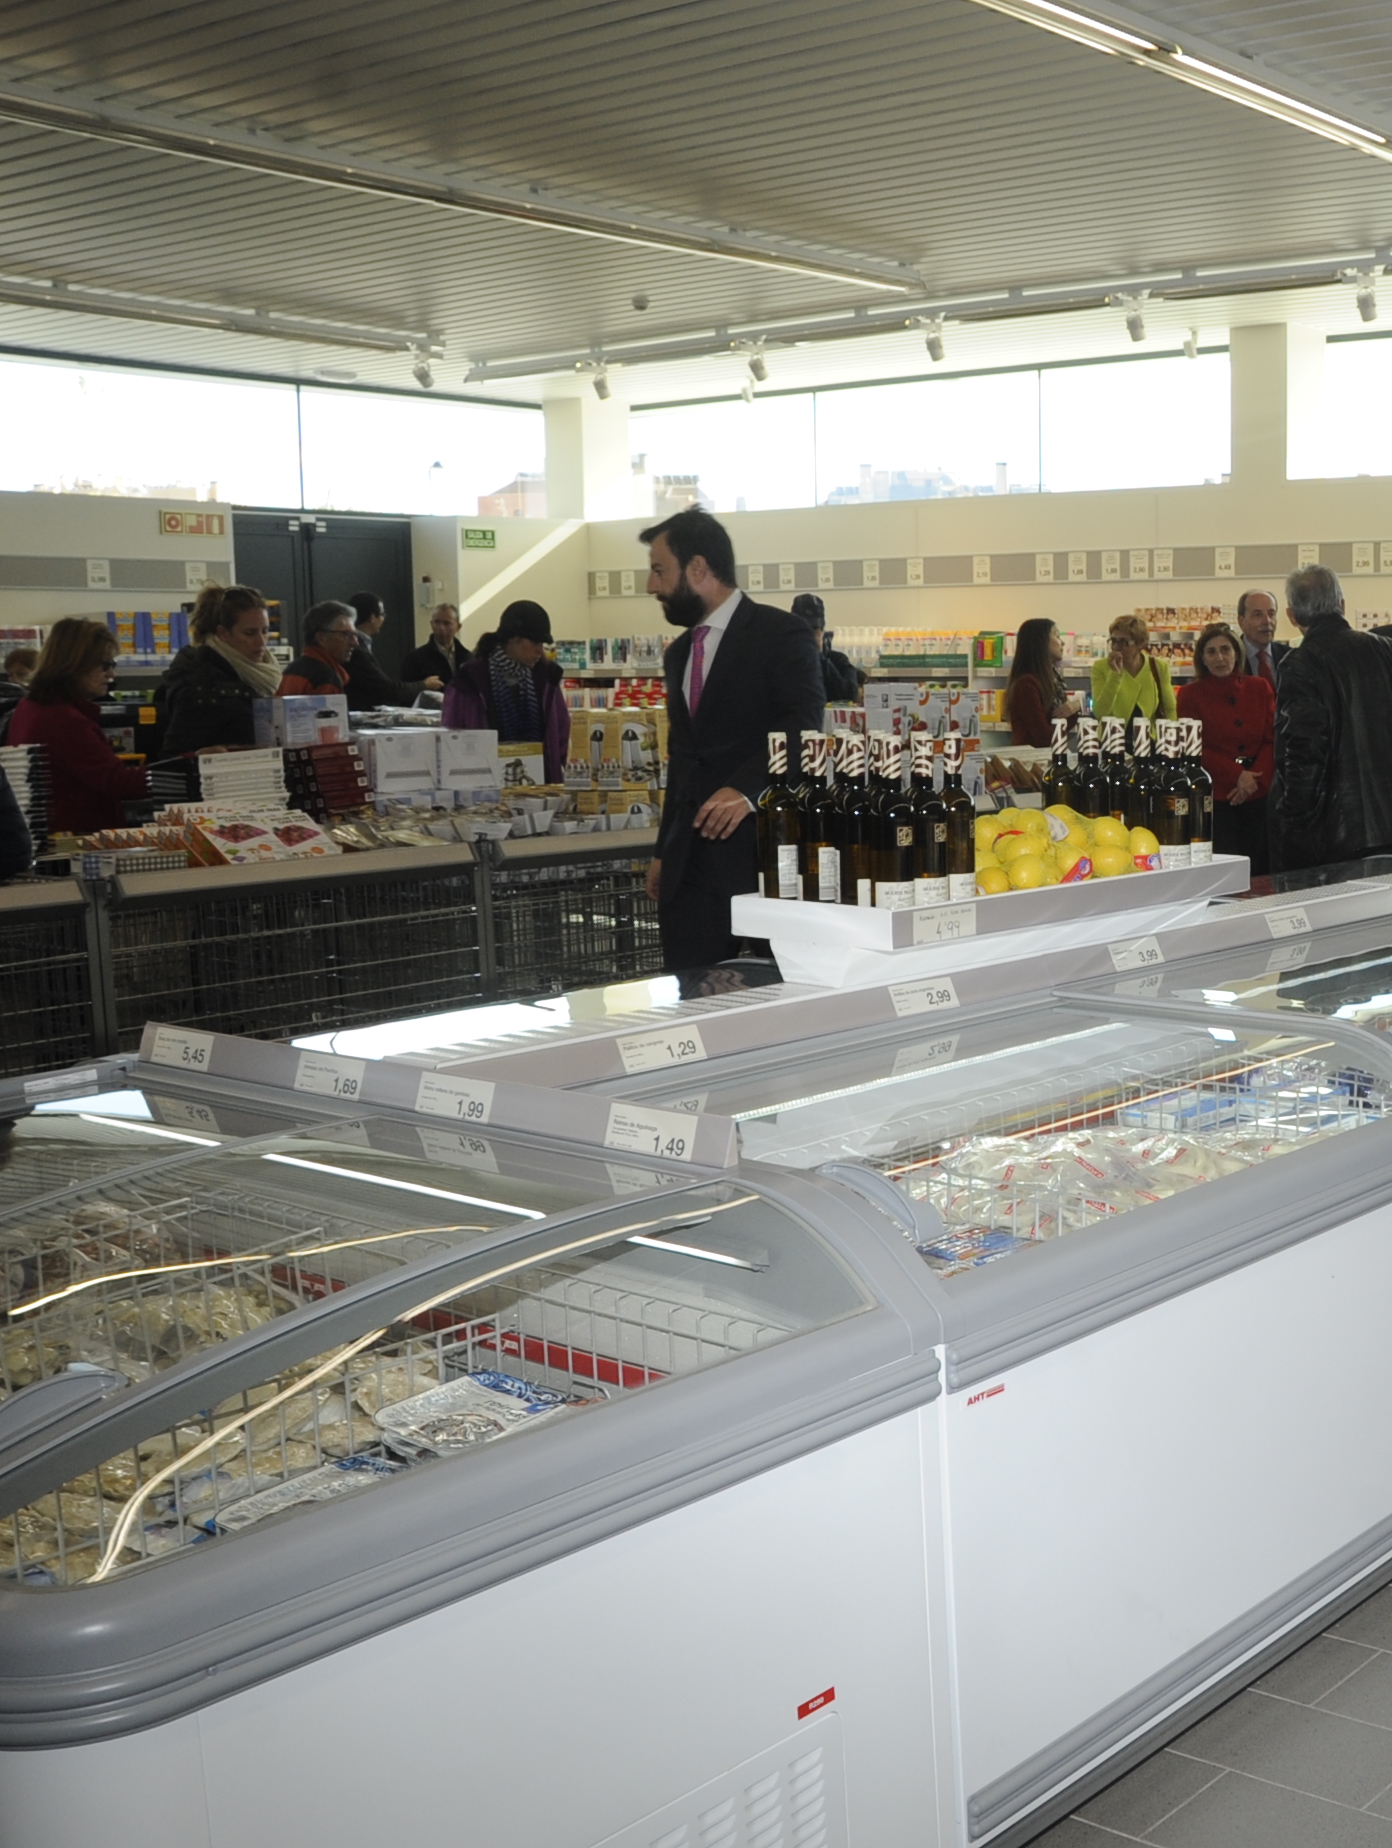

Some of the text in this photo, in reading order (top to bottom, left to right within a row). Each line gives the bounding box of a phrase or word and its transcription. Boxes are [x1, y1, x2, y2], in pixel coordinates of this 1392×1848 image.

[1355, 560, 1370, 568] 2,99
[1138, 949, 1159, 964] 3,99
[926, 989, 951, 1006] 2,99
[182, 1046, 206, 1064] 5,45
[666, 1040, 697, 1060] 1,29
[333, 1077, 358, 1096] 1,69
[457, 1099, 484, 1119] 1,99
[653, 1134, 686, 1157] 1,49
[967, 1391, 985, 1406] AHT
